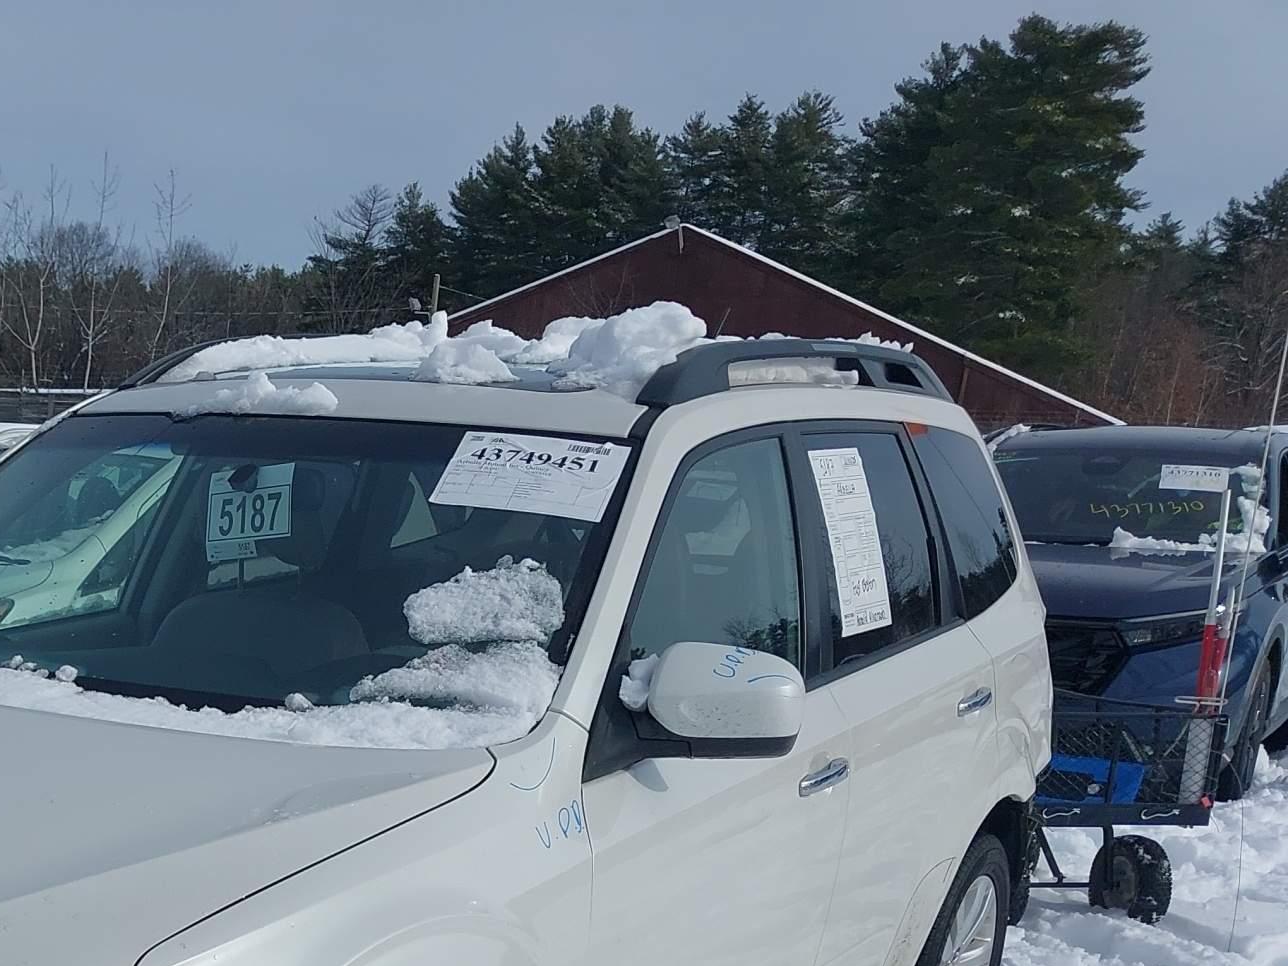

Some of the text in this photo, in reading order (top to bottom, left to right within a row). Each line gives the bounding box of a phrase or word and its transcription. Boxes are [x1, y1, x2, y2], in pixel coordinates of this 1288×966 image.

[471, 446, 601, 473] 43749451
[218, 492, 283, 537] 5187
[1090, 500, 1205, 520] 43771310
